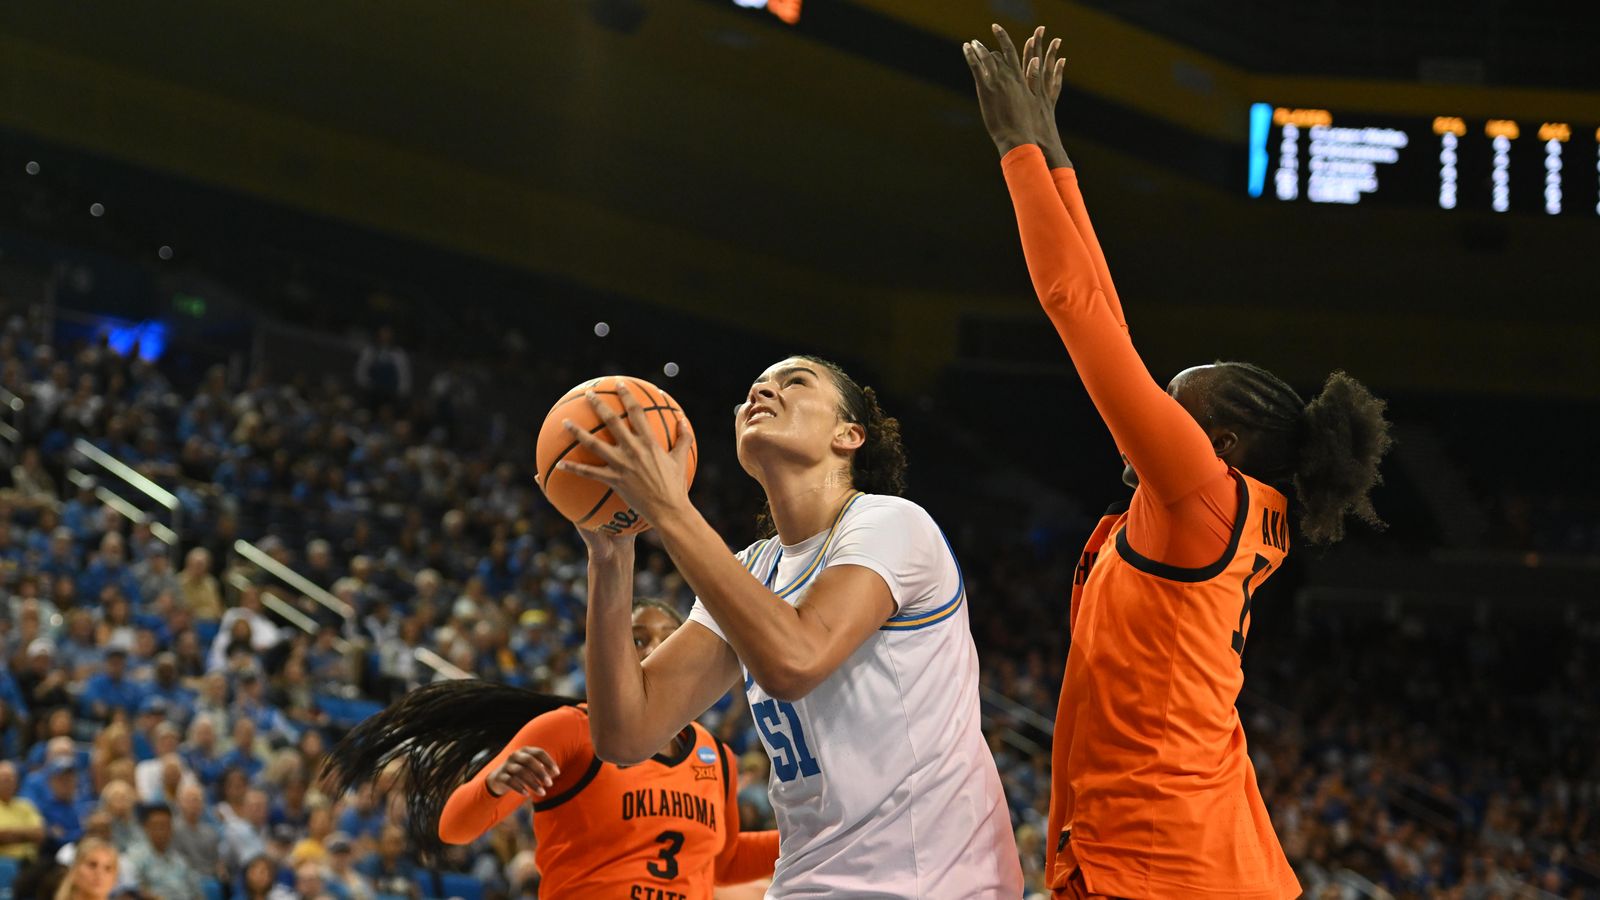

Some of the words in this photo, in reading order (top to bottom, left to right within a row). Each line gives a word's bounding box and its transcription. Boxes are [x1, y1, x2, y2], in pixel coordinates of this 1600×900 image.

[752, 699, 821, 783] 51
[622, 789, 717, 832] OKLAHOMA
[647, 830, 685, 880] 3
